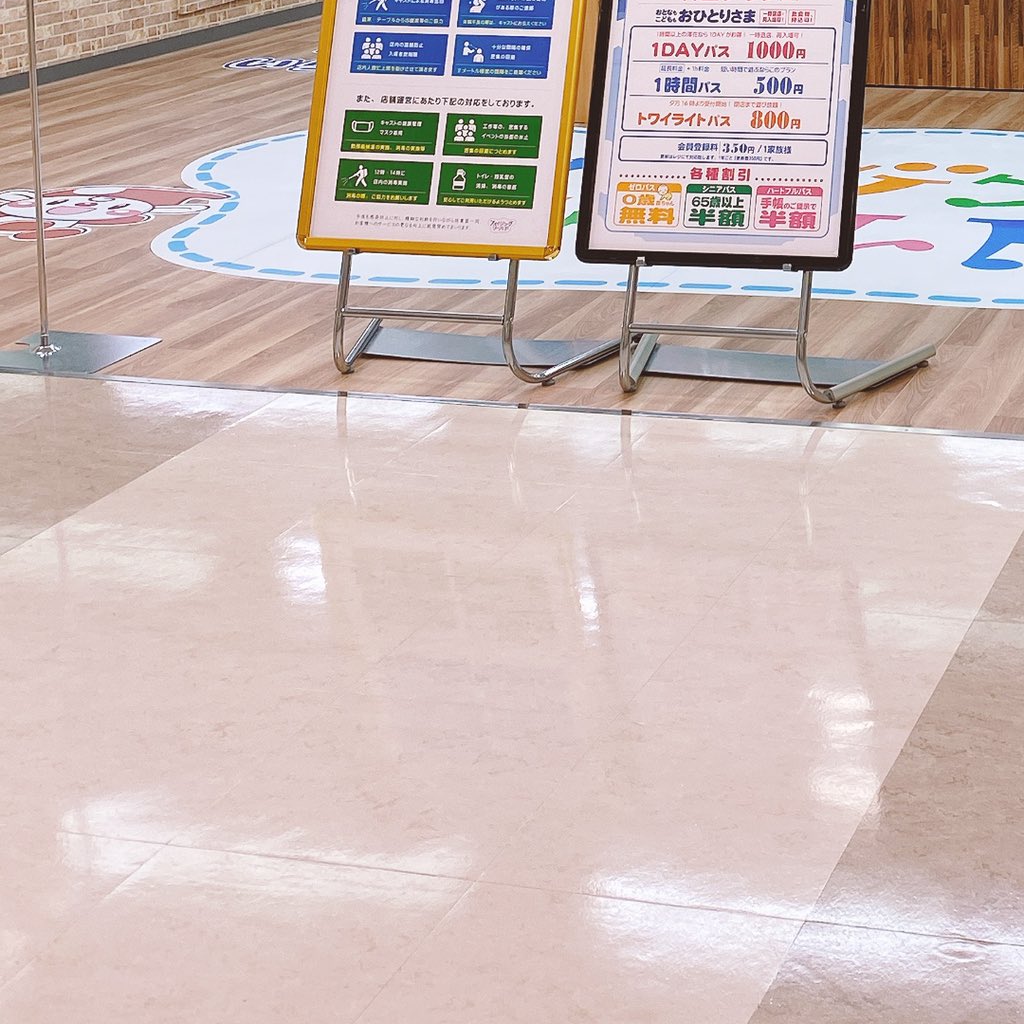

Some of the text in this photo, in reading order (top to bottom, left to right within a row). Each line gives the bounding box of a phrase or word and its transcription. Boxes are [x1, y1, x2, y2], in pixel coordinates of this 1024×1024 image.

[678, 8, 756, 23] おひとりさま
[652, 41, 806, 59] 1DAYパス 1000円
[654, 76, 803, 95] 1時間パス 500円
[638, 110, 801, 130] トワイライトパス 800円
[678, 143, 718, 151] 会員登録料
[690, 167, 751, 182] 各種割引
[627, 183, 656, 191] ゼロパス
[702, 185, 736, 194] シニアパス
[766, 187, 812, 195] ハートフルパス
[692, 196, 744, 209] 65歳以上
[760, 197, 817, 210] 手帳のご提示で
[619, 207, 675, 225] 無料
[688, 208, 746, 228] 半額
[759, 211, 816, 229] 半額
